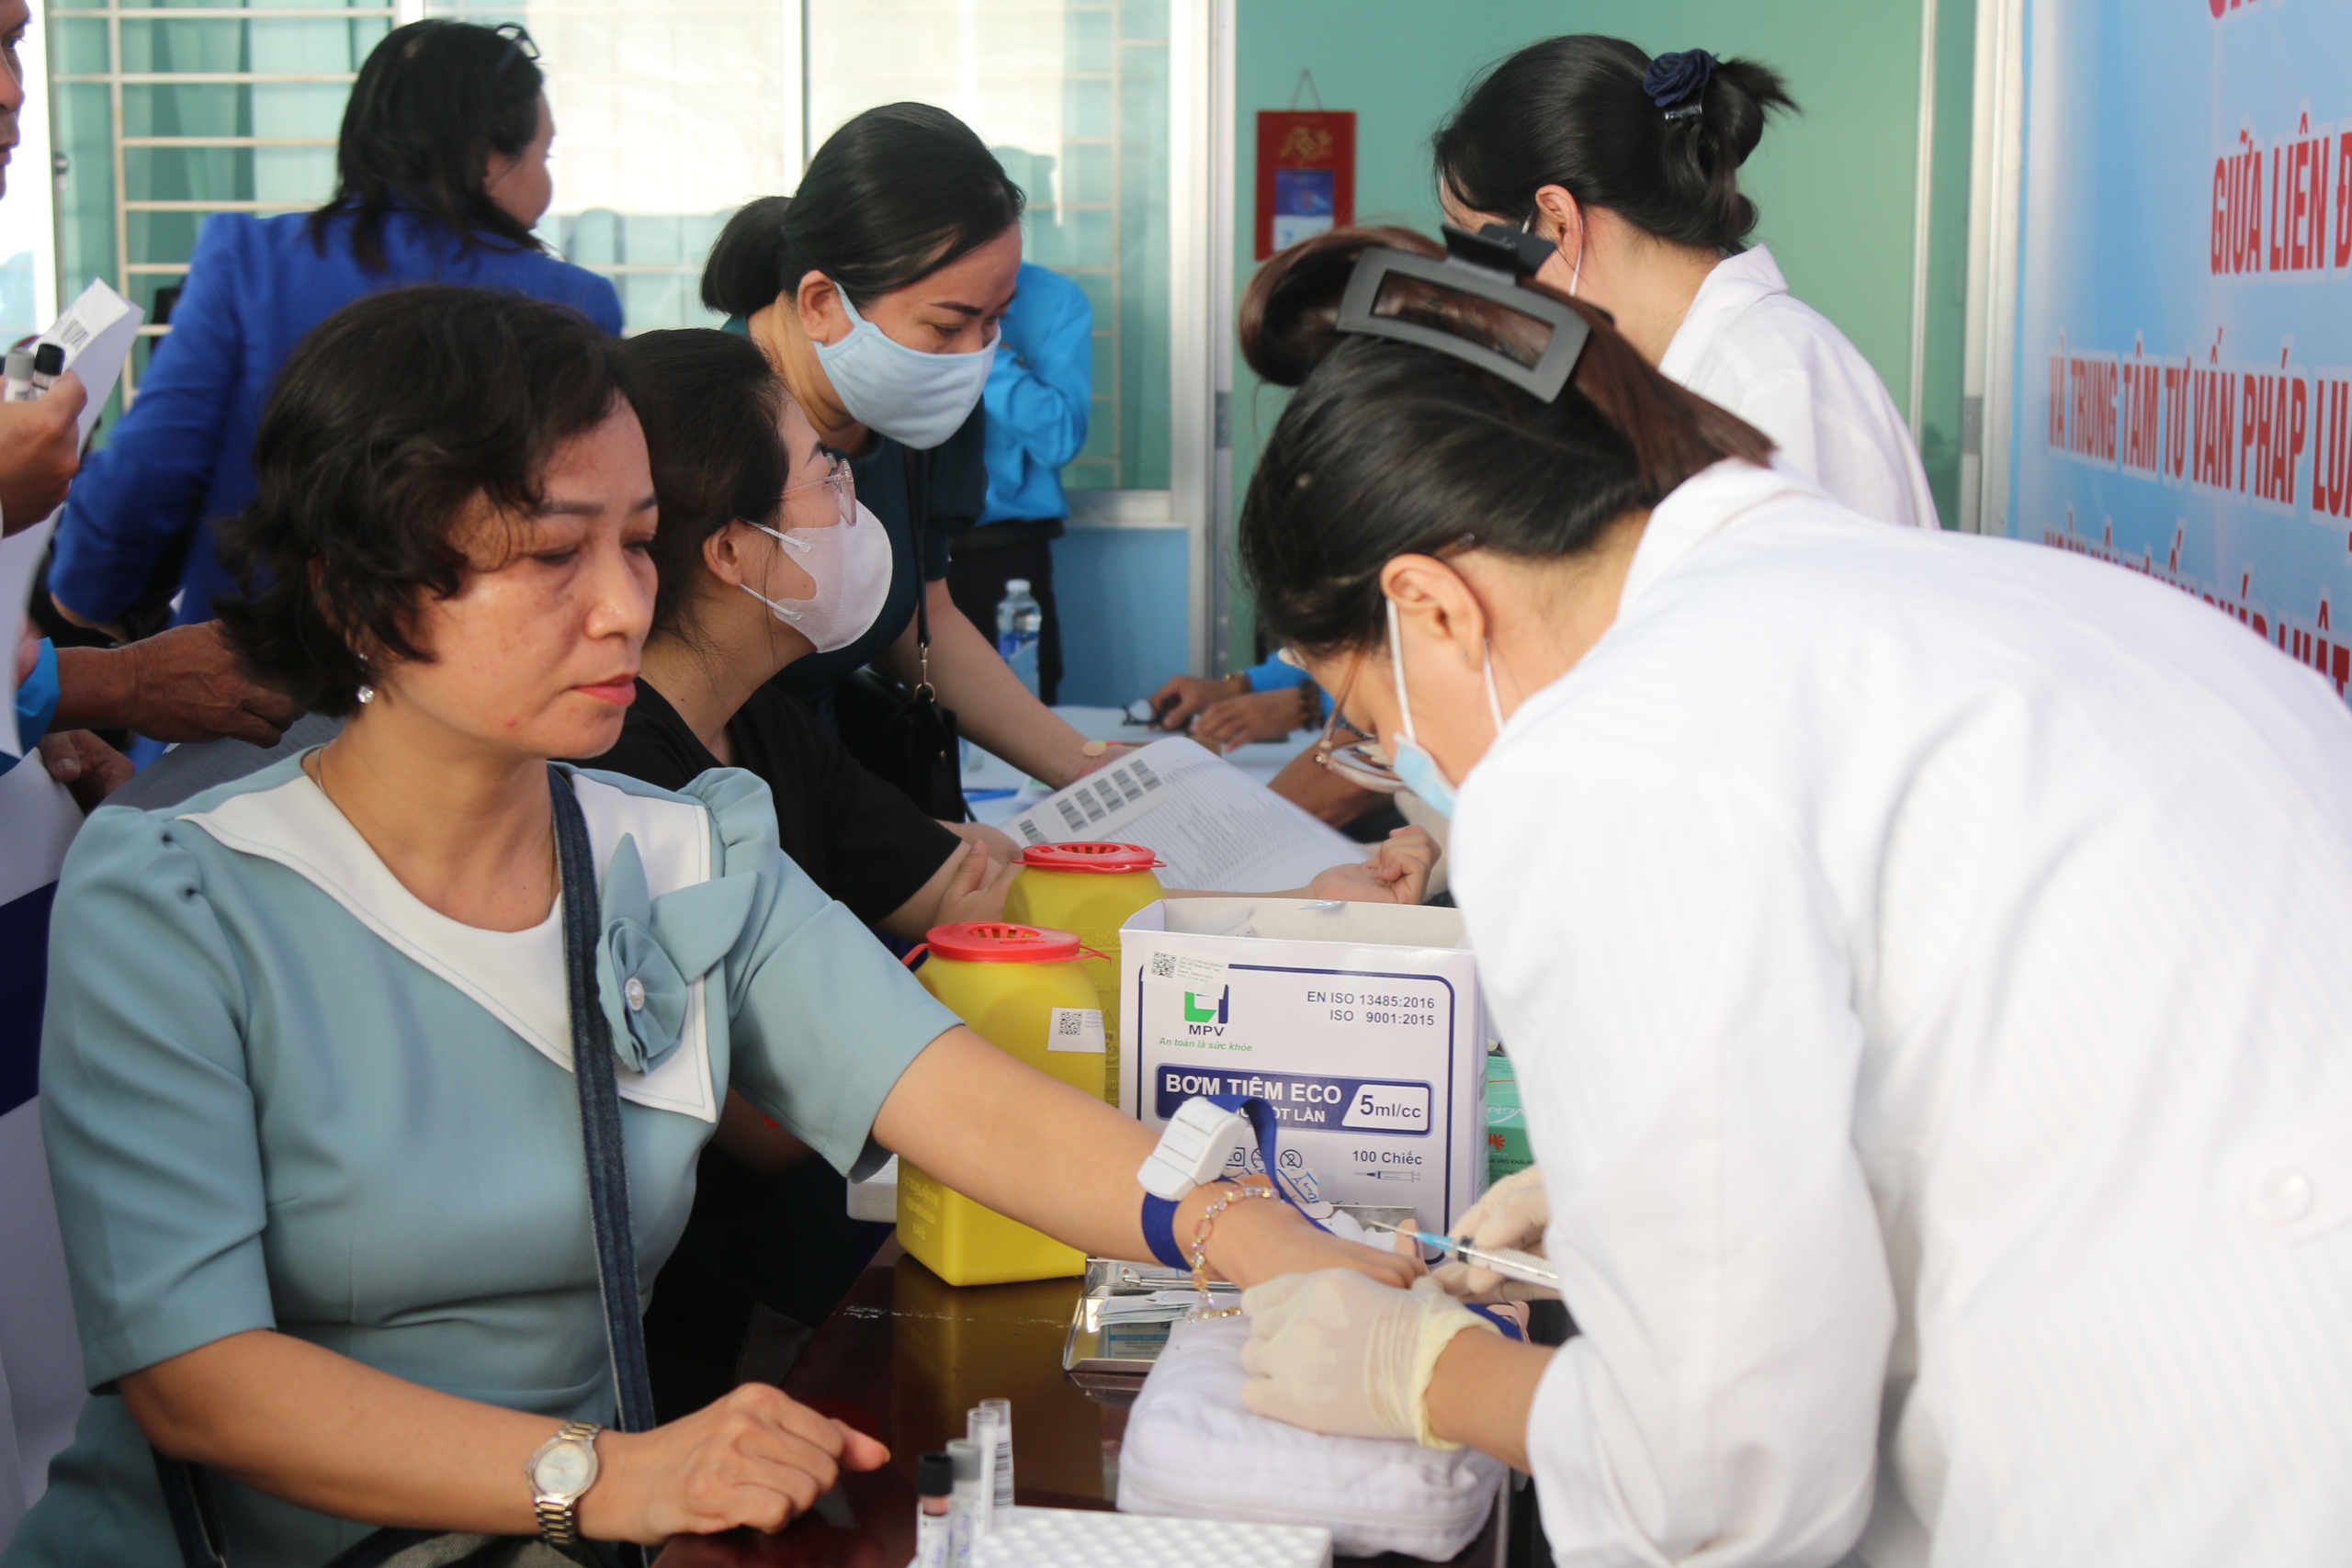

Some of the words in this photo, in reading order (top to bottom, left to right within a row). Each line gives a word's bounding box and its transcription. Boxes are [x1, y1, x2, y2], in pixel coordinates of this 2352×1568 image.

[2269, 112, 2330, 271] LIÊN
[2070, 357, 2118, 462] TRUNG
[2123, 340, 2159, 472] TÂM
[2165, 355, 2191, 479] TƯ
[2194, 327, 2236, 490] VẤN
[2240, 347, 2307, 504] PHÁP
[1306, 991, 1329, 1004] EN
[1330, 992, 1355, 1005] ISO
[1359, 994, 1435, 1010] 13485:2016
[1329, 1010, 1354, 1021] ISO
[1366, 1011, 1434, 1026] 9001:2015
[1189, 1024, 1225, 1037] MPV
[1159, 1037, 1171, 1045] An
[1165, 1073, 1220, 1096] BƠM
[1227, 1076, 1283, 1101] TIÊM
[1291, 1083, 1342, 1105] ECO
[1360, 1094, 1422, 1120] 5ml/cc
[1352, 1150, 1376, 1163] 100
[1381, 1150, 1423, 1165] Chiếc
